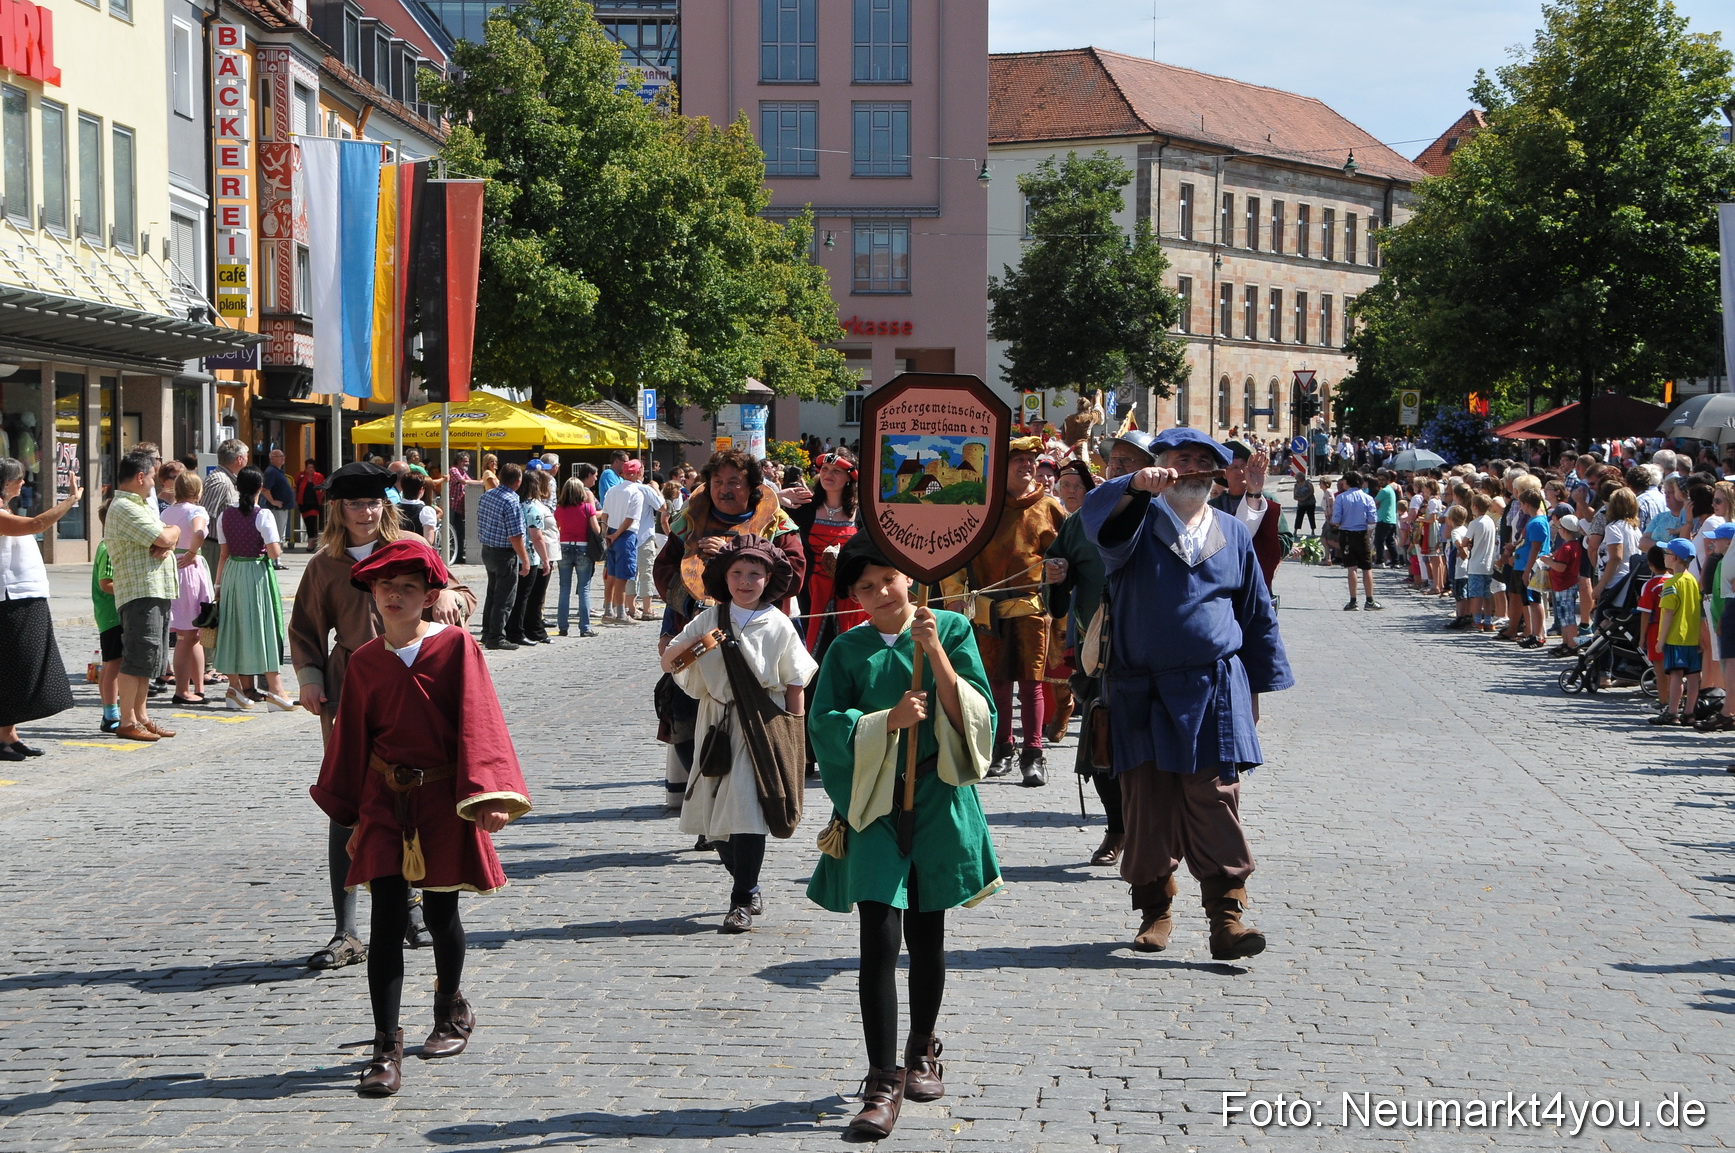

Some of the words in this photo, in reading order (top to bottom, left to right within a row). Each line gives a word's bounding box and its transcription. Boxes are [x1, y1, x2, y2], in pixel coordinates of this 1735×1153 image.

[217, 26, 241, 255] BÄCKEREI
[219, 267, 247, 283] café
[219, 298, 247, 313] plank
[838, 315, 914, 336] rkasse
[645, 393, 654, 417] P
[880, 400, 992, 424] Fördergemeinschaft
[424, 430, 440, 438] Café
[879, 420, 907, 433] Burg
[909, 418, 968, 435] Burgthann
